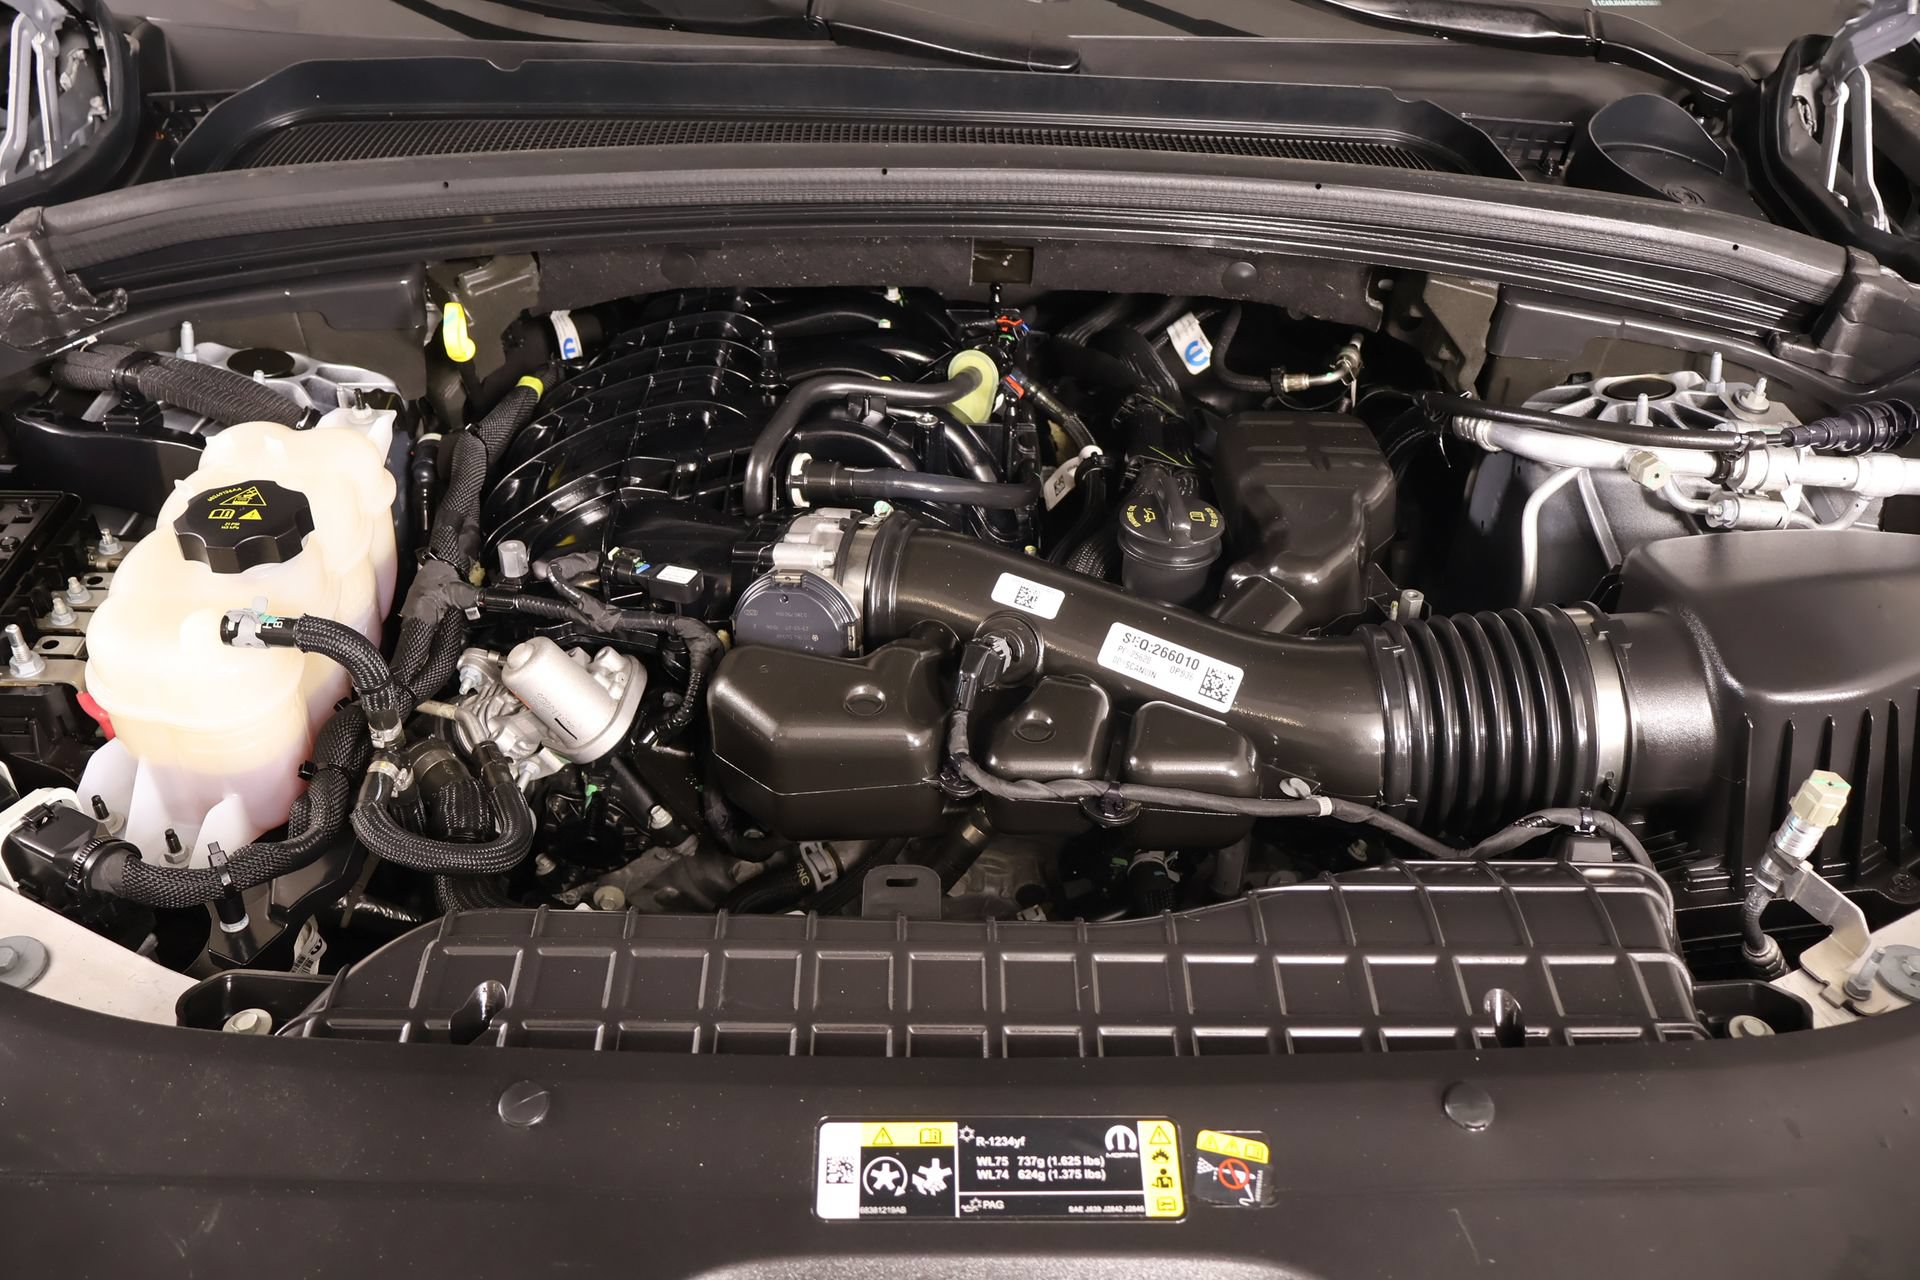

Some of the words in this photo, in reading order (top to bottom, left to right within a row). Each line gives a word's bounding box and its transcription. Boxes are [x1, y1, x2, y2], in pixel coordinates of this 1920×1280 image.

[975, 1136, 1026, 1149] R-1234yf
[976, 1156, 1009, 1167] WL75
[1017, 1156, 1046, 1169] 737g
[1047, 1155, 1082, 1169] (1.625
[1083, 1155, 1106, 1169] lbs)
[976, 1169, 1010, 1180] WL74
[1017, 1169, 1046, 1182] 624g
[1048, 1168, 1083, 1182] (1.375
[1084, 1168, 1107, 1182] lbs)
[982, 1200, 1005, 1210] PAG
